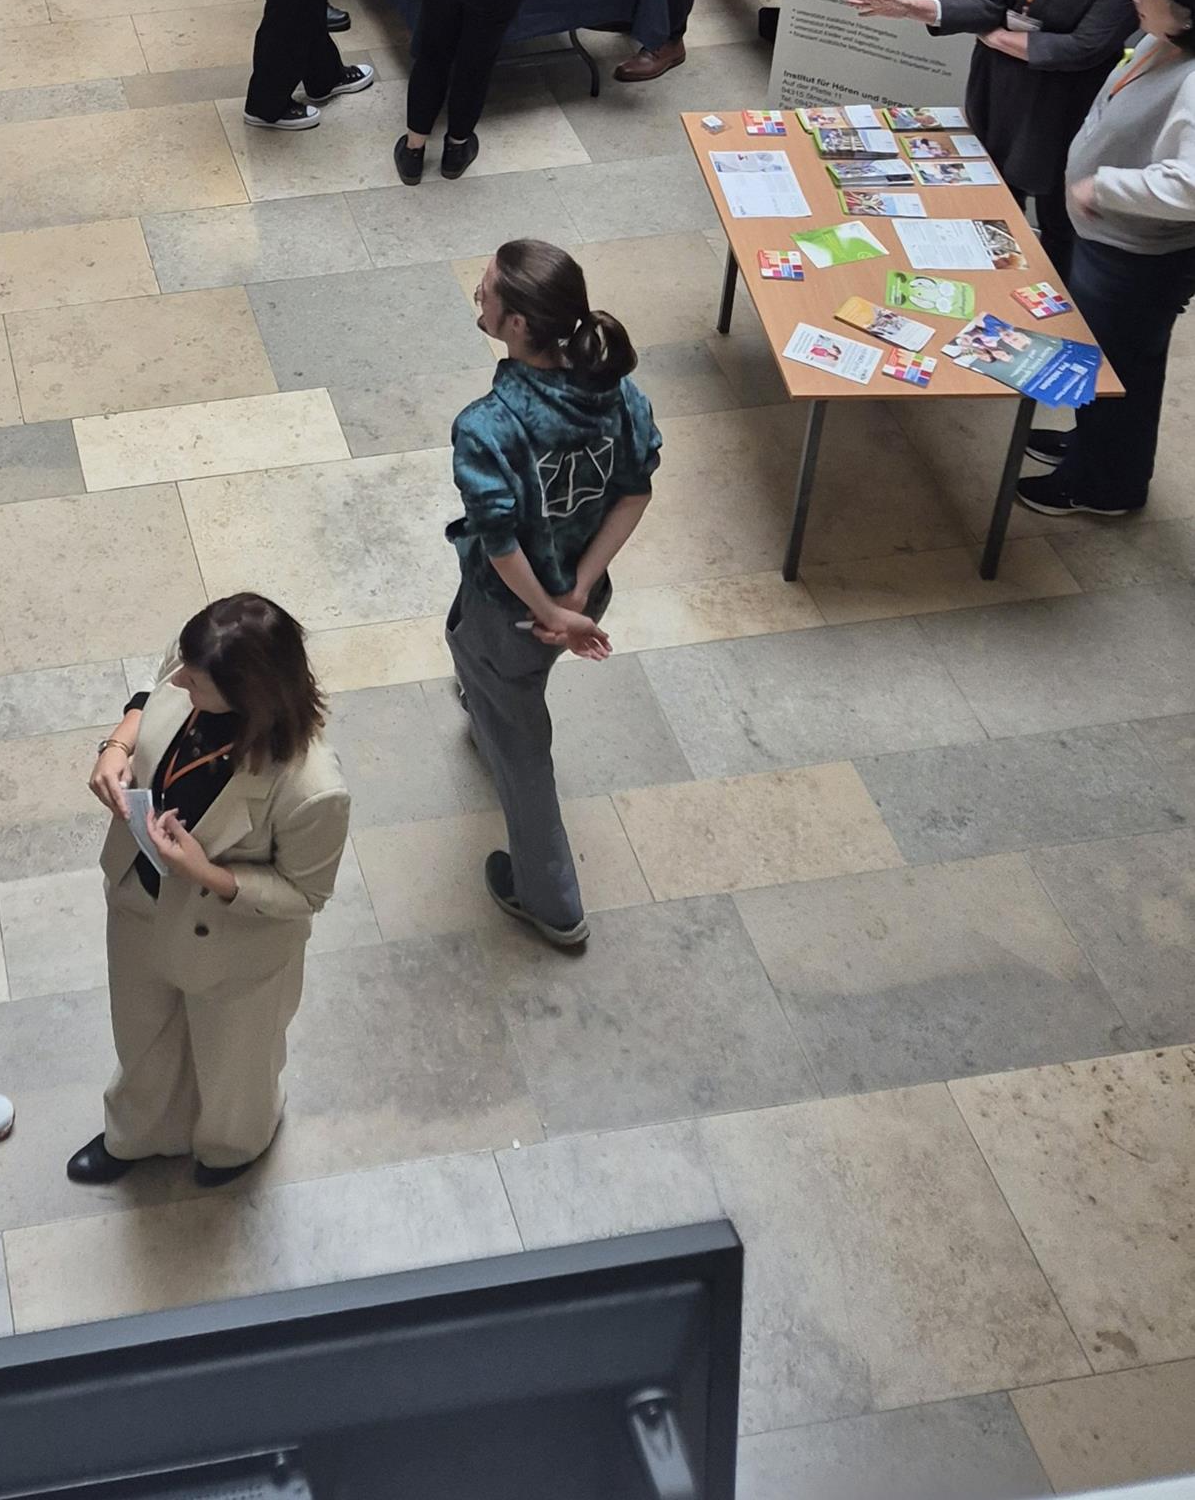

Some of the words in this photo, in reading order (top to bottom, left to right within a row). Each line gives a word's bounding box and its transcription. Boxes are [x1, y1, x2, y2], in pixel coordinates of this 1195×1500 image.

[783, 70, 815, 85] Institut
[816, 77, 830, 88] für
[832, 81, 860, 97] Hören
[862, 91, 880, 103] und
[881, 96, 919, 111] Sprach
